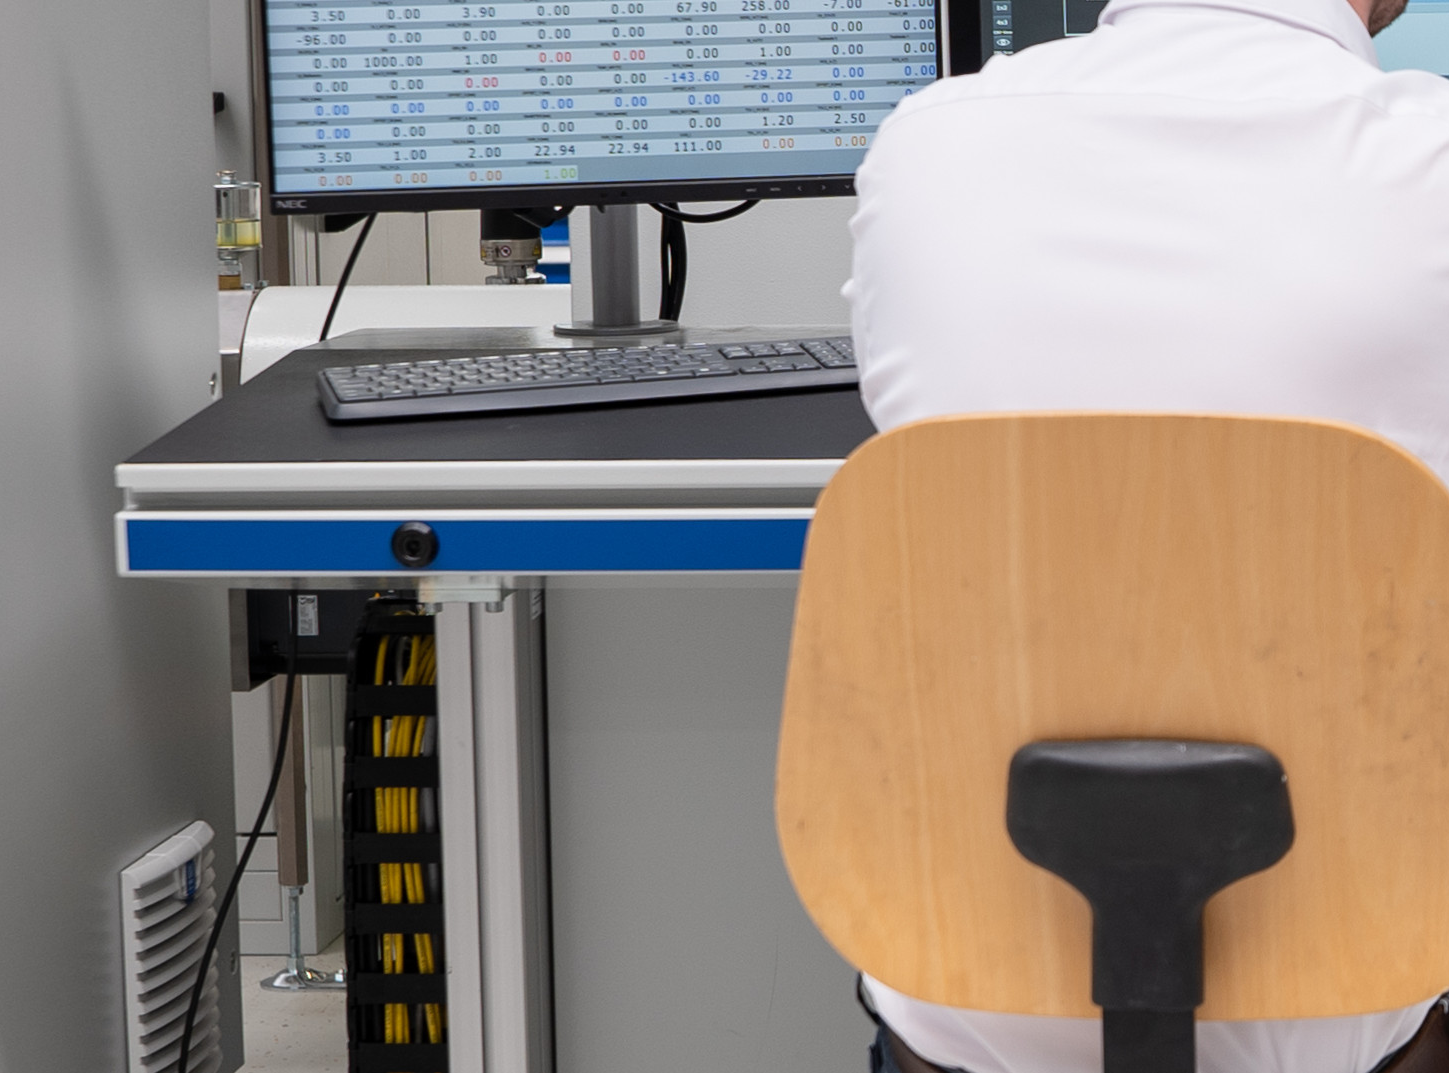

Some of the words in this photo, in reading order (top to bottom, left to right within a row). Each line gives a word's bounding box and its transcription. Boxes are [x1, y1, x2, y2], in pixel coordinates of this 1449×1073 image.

[311, 11, 345, 21] 3.50
[387, 9, 420, 20] 0.00
[463, 7, 496, 18] 3.90
[537, 5, 570, 16] 0.00
[611, 3, 644, 14] 0.00
[676, 1, 717, 12] 67.90
[742, 0, 790, 10] 258.00
[297, 34, 346, 45] -96.00
[389, 33, 422, 43] 0.00
[464, 30, 497, 41] 0.00
[538, 29, 571, 39] 0.00
[612, 27, 644, 37] 0.00
[686, 25, 718, 36] 0.00
[759, 23, 790, 34] 0.00
[831, 21, 863, 32] 0.00
[903, 19, 935, 30] 0.00
[314, 58, 347, 68] 0.00
[364, 56, 422, 67] 1000.00
[466, 54, 497, 65] 1.00
[539, 52, 572, 63] 0.00
[613, 50, 645, 60] 0.00
[686, 48, 718, 59] 0.00
[760, 46, 792, 57] 1.00
[832, 44, 864, 55] 0.00
[904, 42, 935, 53] 0.00
[315, 81, 348, 92] 0.00
[390, 79, 423, 90] 0.00
[465, 77, 498, 88] 0.00
[540, 75, 573, 86] 0.00
[614, 74, 646, 84] 0.00
[663, 71, 719, 82] -143.60
[745, 69, 792, 80] -29.22
[833, 67, 864, 78] 0.00
[905, 65, 936, 76] 0.00
[315, 105, 349, 116] 0.00
[391, 103, 425, 113] 0.00
[466, 100, 499, 111] 0.00
[541, 98, 574, 109] 0.00
[614, 96, 647, 107] 0.00
[688, 94, 720, 105] 0.00
[761, 92, 793, 103] 0.00
[833, 90, 865, 101] 0.00
[316, 128, 350, 140] 0.00
[392, 126, 426, 137] 0.00
[468, 124, 500, 135] 0.00
[542, 122, 574, 132] 0.00
[616, 120, 648, 130] 0.00
[689, 117, 721, 128] 0.00
[763, 115, 794, 126] 1.20
[834, 113, 866, 124] 2.50
[318, 152, 352, 163] 3.50
[394, 150, 427, 160] 1.00
[468, 147, 501, 158] 2.00
[534, 145, 575, 156] 22.94
[609, 143, 649, 154] 22.94
[674, 141, 722, 152] 111.00
[762, 138, 794, 149] 0.00
[834, 136, 866, 147] 0.00
[318, 176, 352, 186] 0.00
[394, 173, 428, 183] 0.00
[469, 170, 502, 181] 0.00
[544, 168, 577, 179] 1.00
[276, 200, 307, 208] NEC
